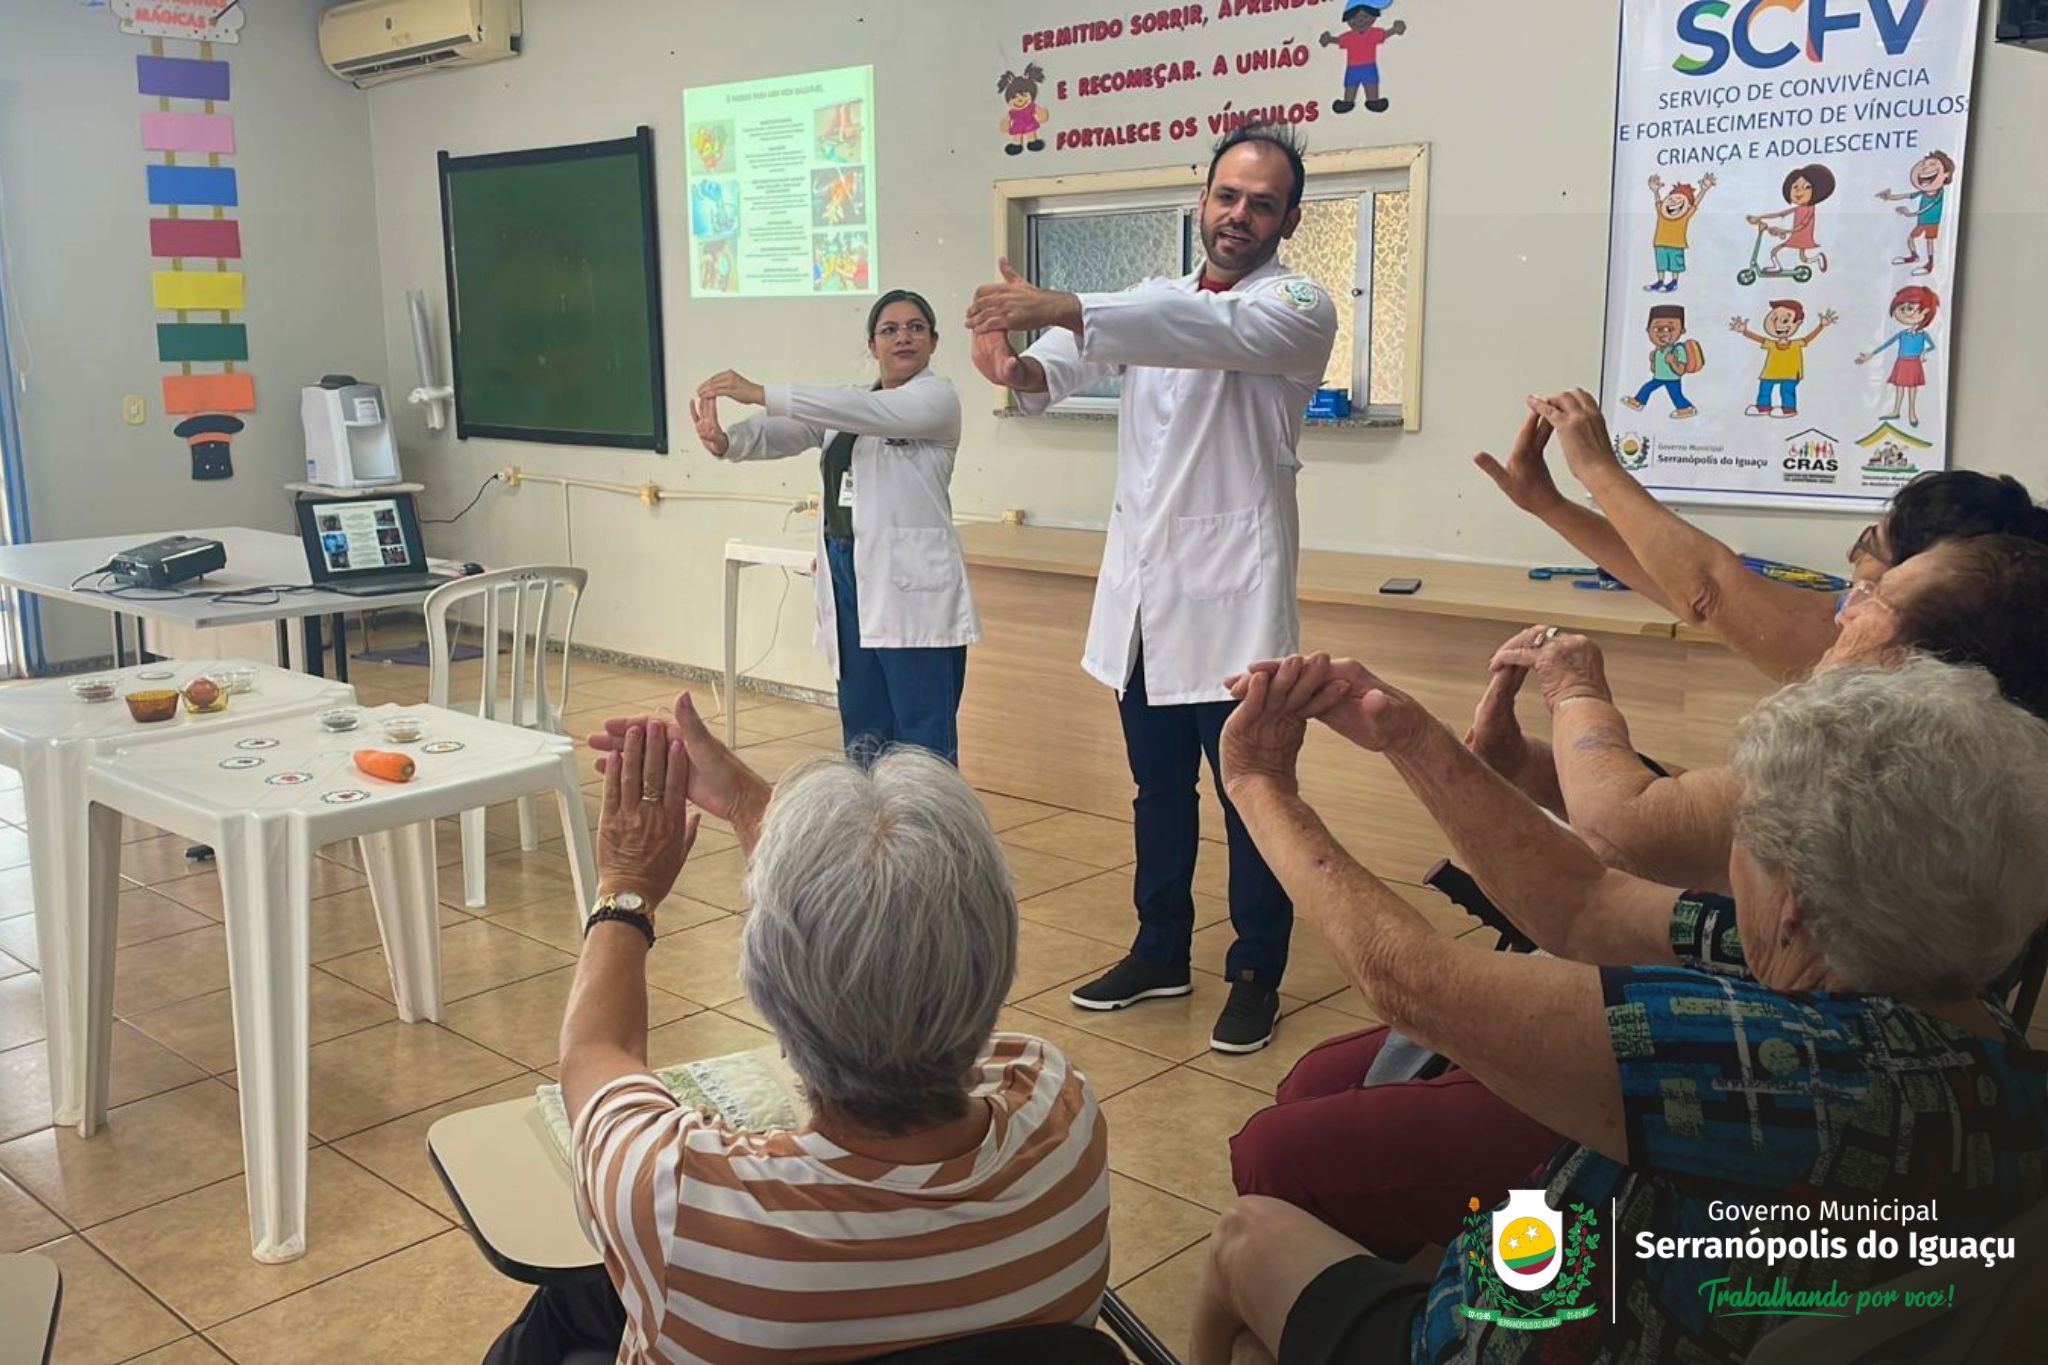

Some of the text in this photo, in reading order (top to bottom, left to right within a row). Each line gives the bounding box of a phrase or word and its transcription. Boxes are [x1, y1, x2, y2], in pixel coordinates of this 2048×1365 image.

[1022, 19, 1123, 52] PERMITIDO
[1130, 4, 1208, 35] SORRIR,
[1671, 0, 1931, 76] SCFV
[1056, 37, 1309, 100] E RECOMEÇAR. A UNIÃO
[1658, 67, 1930, 110] SERVIÇO DE CONVIVÊNCIA
[1056, 100, 1319, 150] FORTALECE OS VÍNCULOS
[1619, 124, 1631, 141] E
[1636, 108, 1813, 140] FORTALECIMENTO
[1820, 105, 1847, 124] DE
[1657, 130, 1918, 165] CRIANÇA E ADOLESCENTE
[1658, 454, 1768, 468] Serranópolis do Iguaçu
[1783, 458, 1838, 471] CRAS
